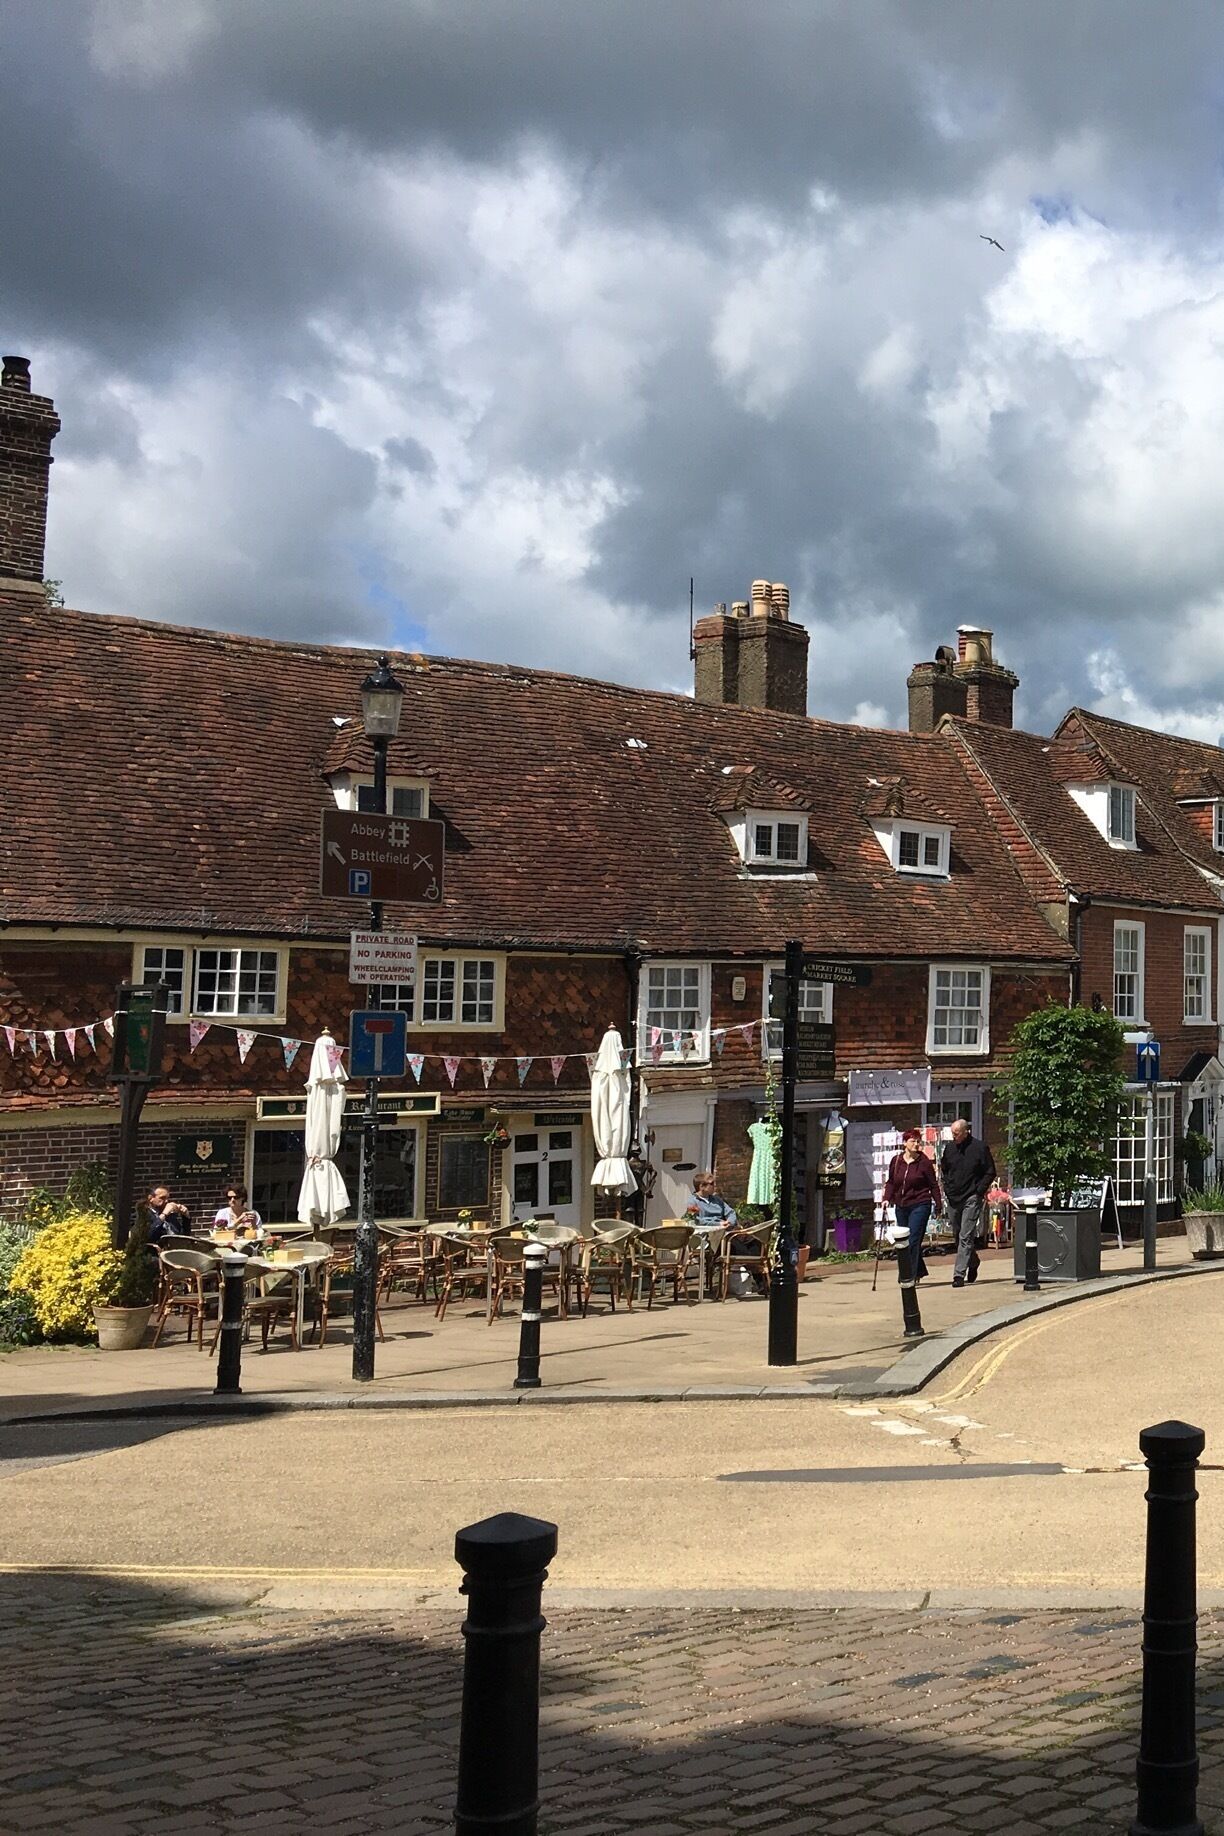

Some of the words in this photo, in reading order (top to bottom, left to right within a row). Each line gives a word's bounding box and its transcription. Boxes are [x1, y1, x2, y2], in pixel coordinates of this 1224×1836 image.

[350, 823, 387, 839] Abbey
[350, 848, 411, 865] Battlefield
[354, 872, 369, 893] P
[355, 934, 389, 943] PRIVATE
[393, 936, 415, 945] ROAD
[357, 950, 370, 958] NO
[375, 950, 412, 959] PARKING
[353, 964, 415, 974] WHEELCLAMPING
[807, 963, 834, 973] CRICKET
[834, 966, 852, 974] FIELD
[370, 973, 411, 982] OPERATION
[806, 971, 832, 981] MARKET
[833, 973, 857, 983] SQUARE
[880, 1076, 890, 1089] &
[350, 1100, 401, 1112] Reurant
[541, 1151, 549, 1161] 2
